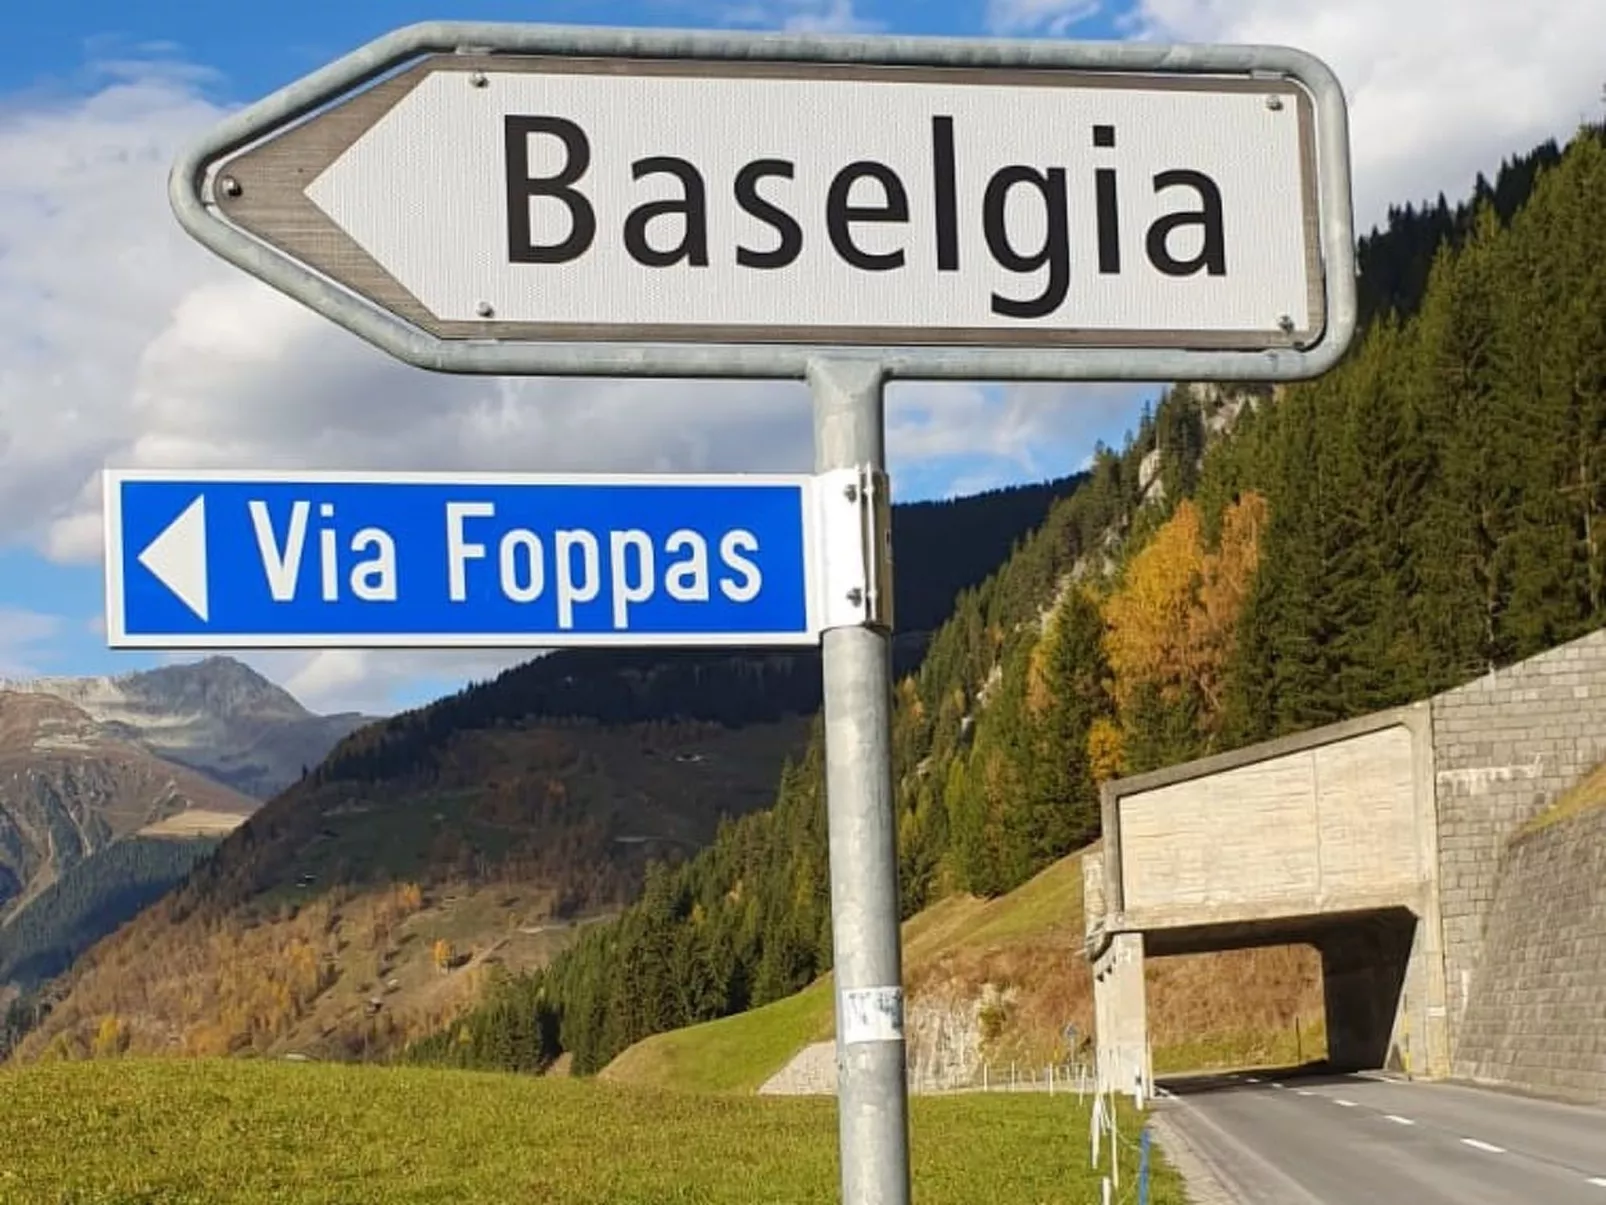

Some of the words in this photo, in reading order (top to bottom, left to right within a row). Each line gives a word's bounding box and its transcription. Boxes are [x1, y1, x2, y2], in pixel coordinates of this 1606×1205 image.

[504, 114, 1227, 319] Baselgia
[249, 500, 397, 602] Via
[446, 502, 762, 629] Foppas
